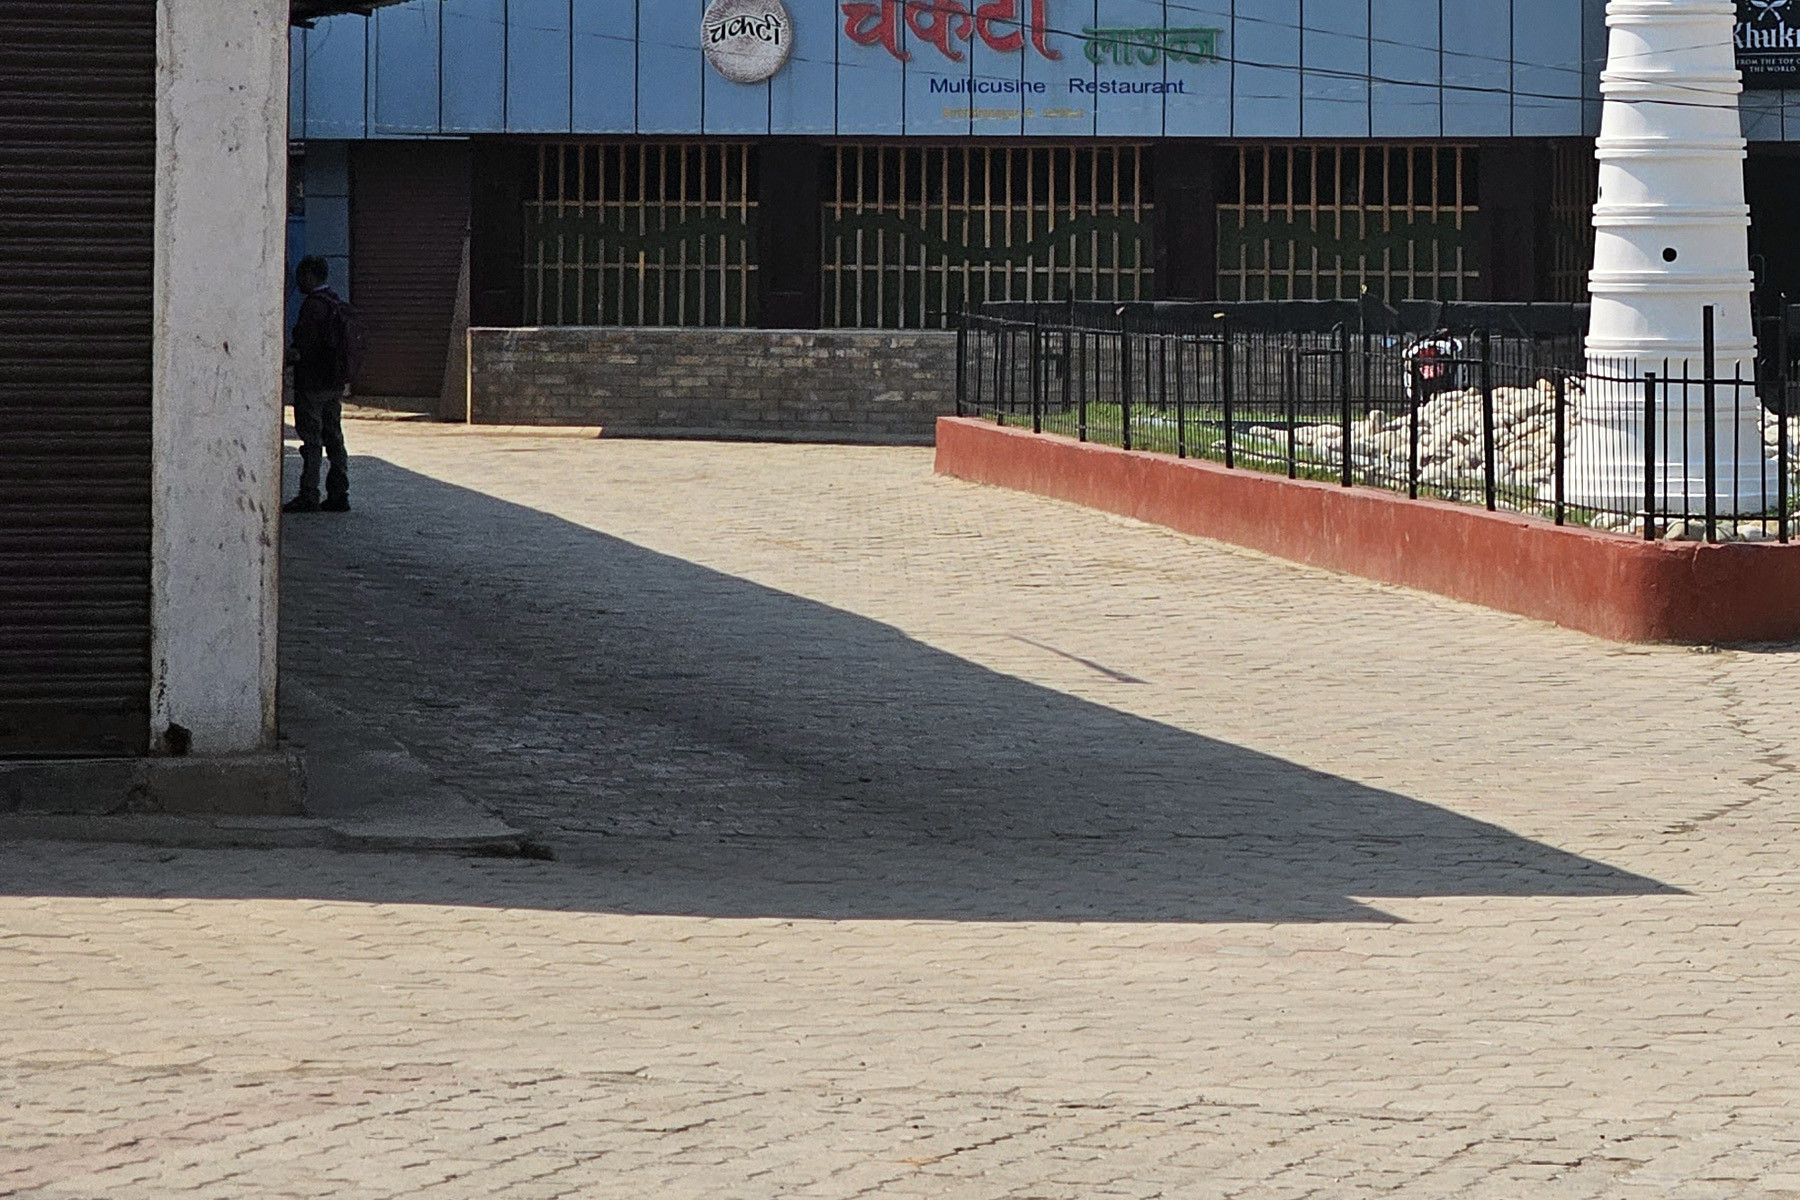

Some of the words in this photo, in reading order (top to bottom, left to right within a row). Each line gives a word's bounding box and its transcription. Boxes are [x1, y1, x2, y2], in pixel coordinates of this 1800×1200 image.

[708, 13, 782, 45] चकटी
[930, 78, 1046, 95] Multicusine
[1068, 77, 1185, 95] Restaurant
